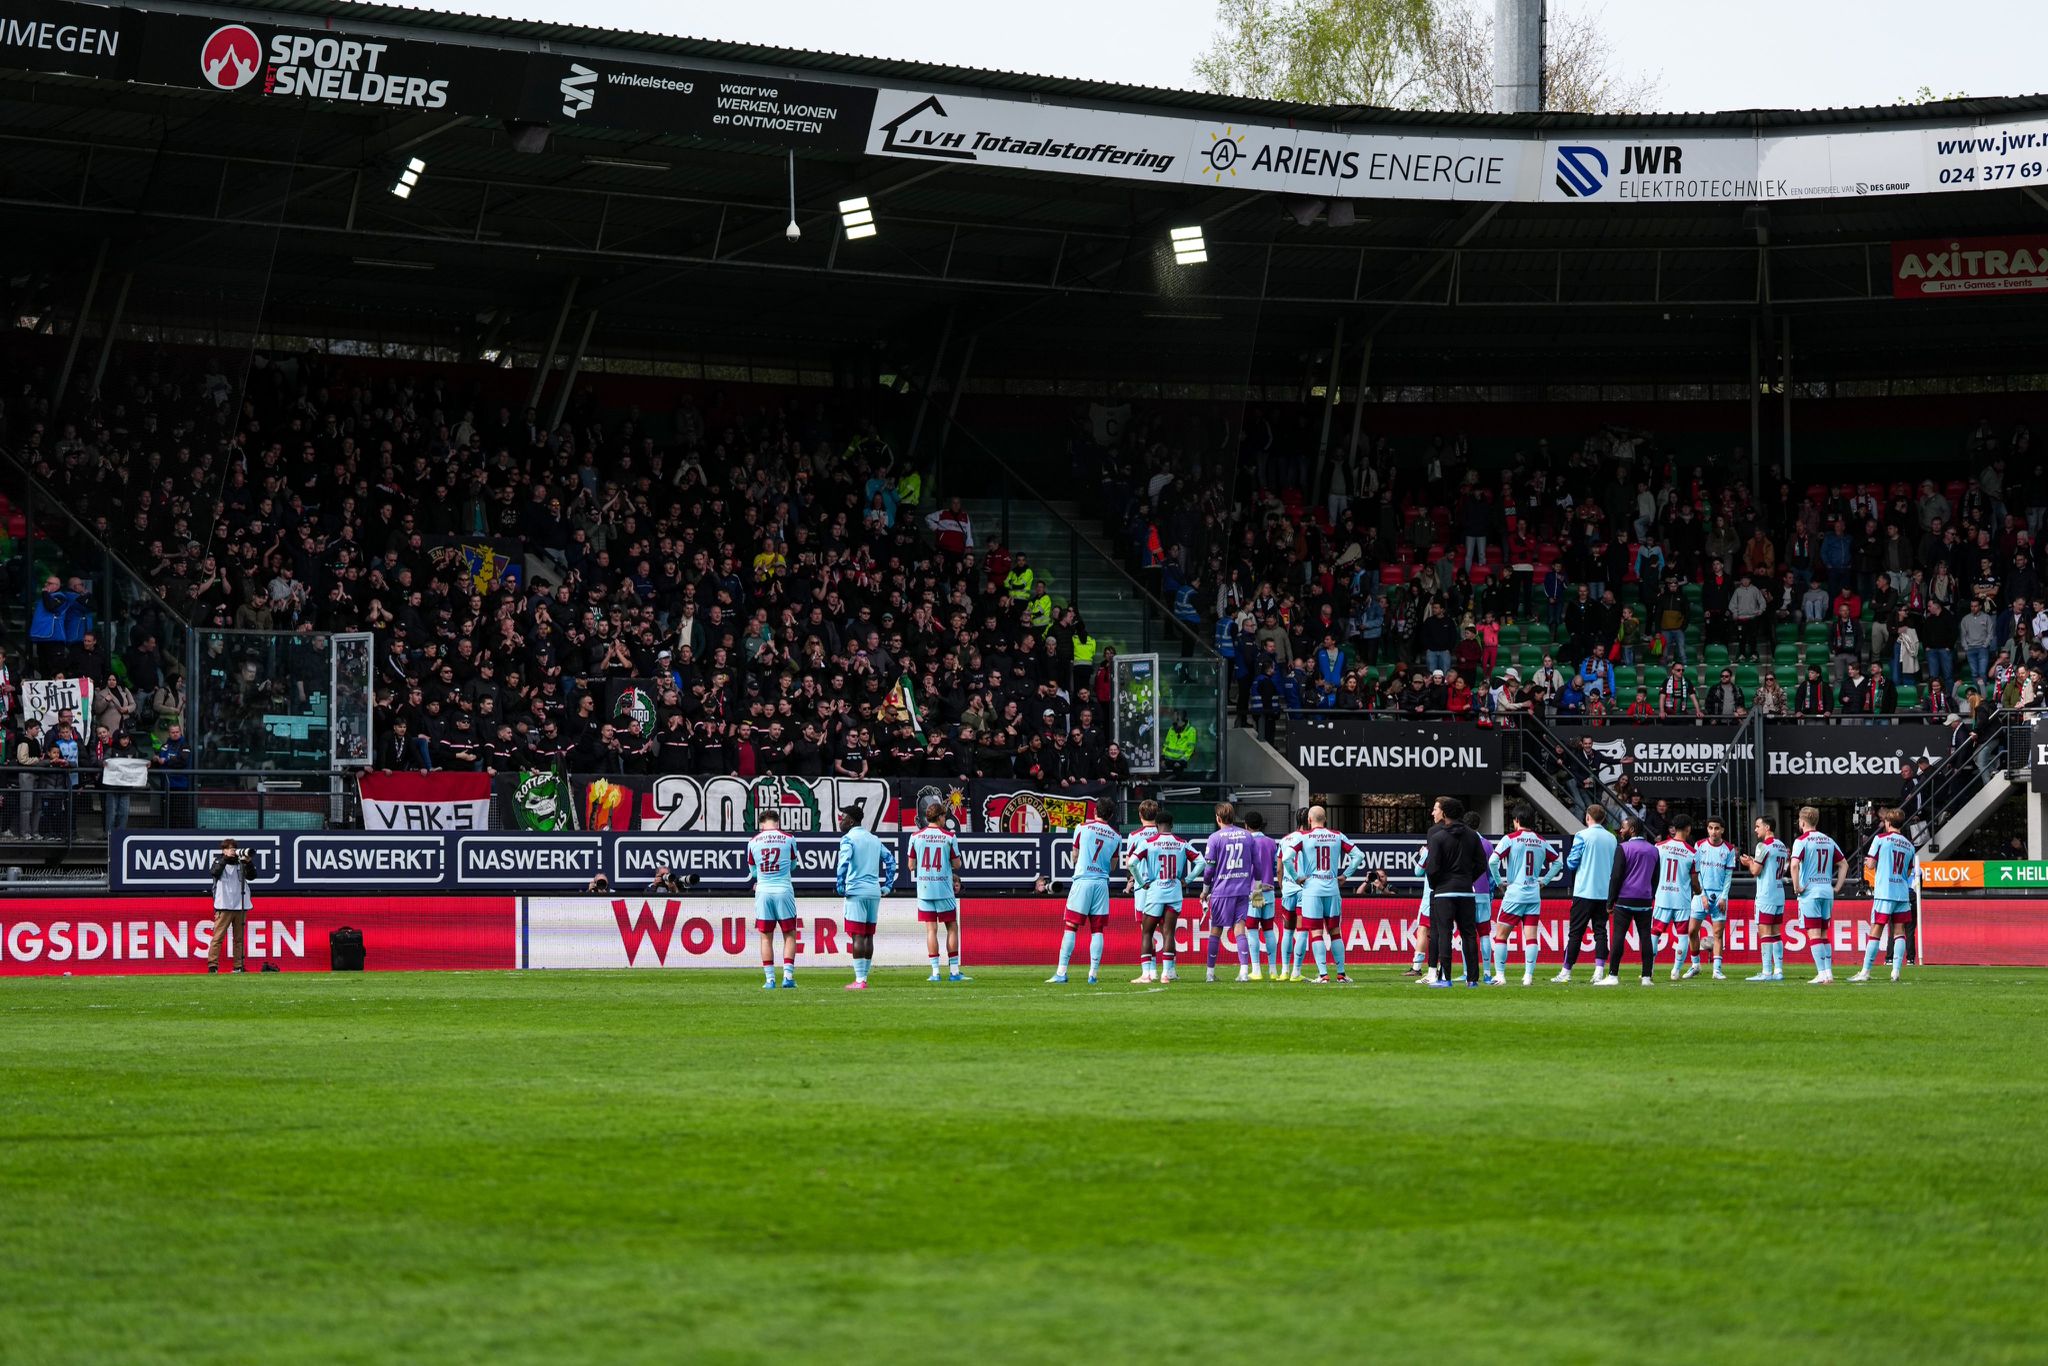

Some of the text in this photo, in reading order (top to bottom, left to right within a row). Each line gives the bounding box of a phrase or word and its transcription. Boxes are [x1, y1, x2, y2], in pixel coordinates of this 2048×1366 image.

[269, 34, 387, 72] SPORT
[264, 65, 277, 93] MET
[273, 65, 449, 108] SNELDERS
[608, 73, 693, 93] winkelsteeg
[720, 83, 778, 98] waar we
[717, 97, 837, 120] WERKEN, WONEN
[713, 115, 822, 134] en ONTMOETEN
[901, 129, 1175, 173] JVH Totaalstoffering
[1937, 131, 2048, 155] www.jwr.
[1252, 145, 1504, 184] ARIENS ENERGIE
[1620, 145, 1682, 174] JWR
[1939, 168, 1975, 184] 024
[1984, 164, 2016, 181] 377
[2020, 161, 2042, 177] 69
[1620, 179, 1787, 198] ELEKTROTECHNIEK
[1791, 187, 1803, 195] EEN
[1804, 186, 1840, 195] ONDERDEEL
[1870, 184, 1884, 192] DES
[1885, 182, 1910, 190] GROUP
[1940, 279, 2032, 290] Fun Games Events
[1300, 746, 1488, 767] NECFANSHOP.NL
[1768, 751, 1900, 775] Heineken
[759, 785, 782, 807] DE
[1004, 796, 1046, 818] FEYENOORD
[921, 847, 942, 872] 44
[1095, 838, 1104, 863] 7
[1225, 843, 1243, 870] 22
[1314, 846, 1330, 871] 18
[1816, 849, 1828, 874] 17
[1158, 855, 1177, 880] 30
[1526, 851, 1534, 876] 9
[1666, 858, 1679, 882] 11
[1934, 867, 1970, 881] KLOK
